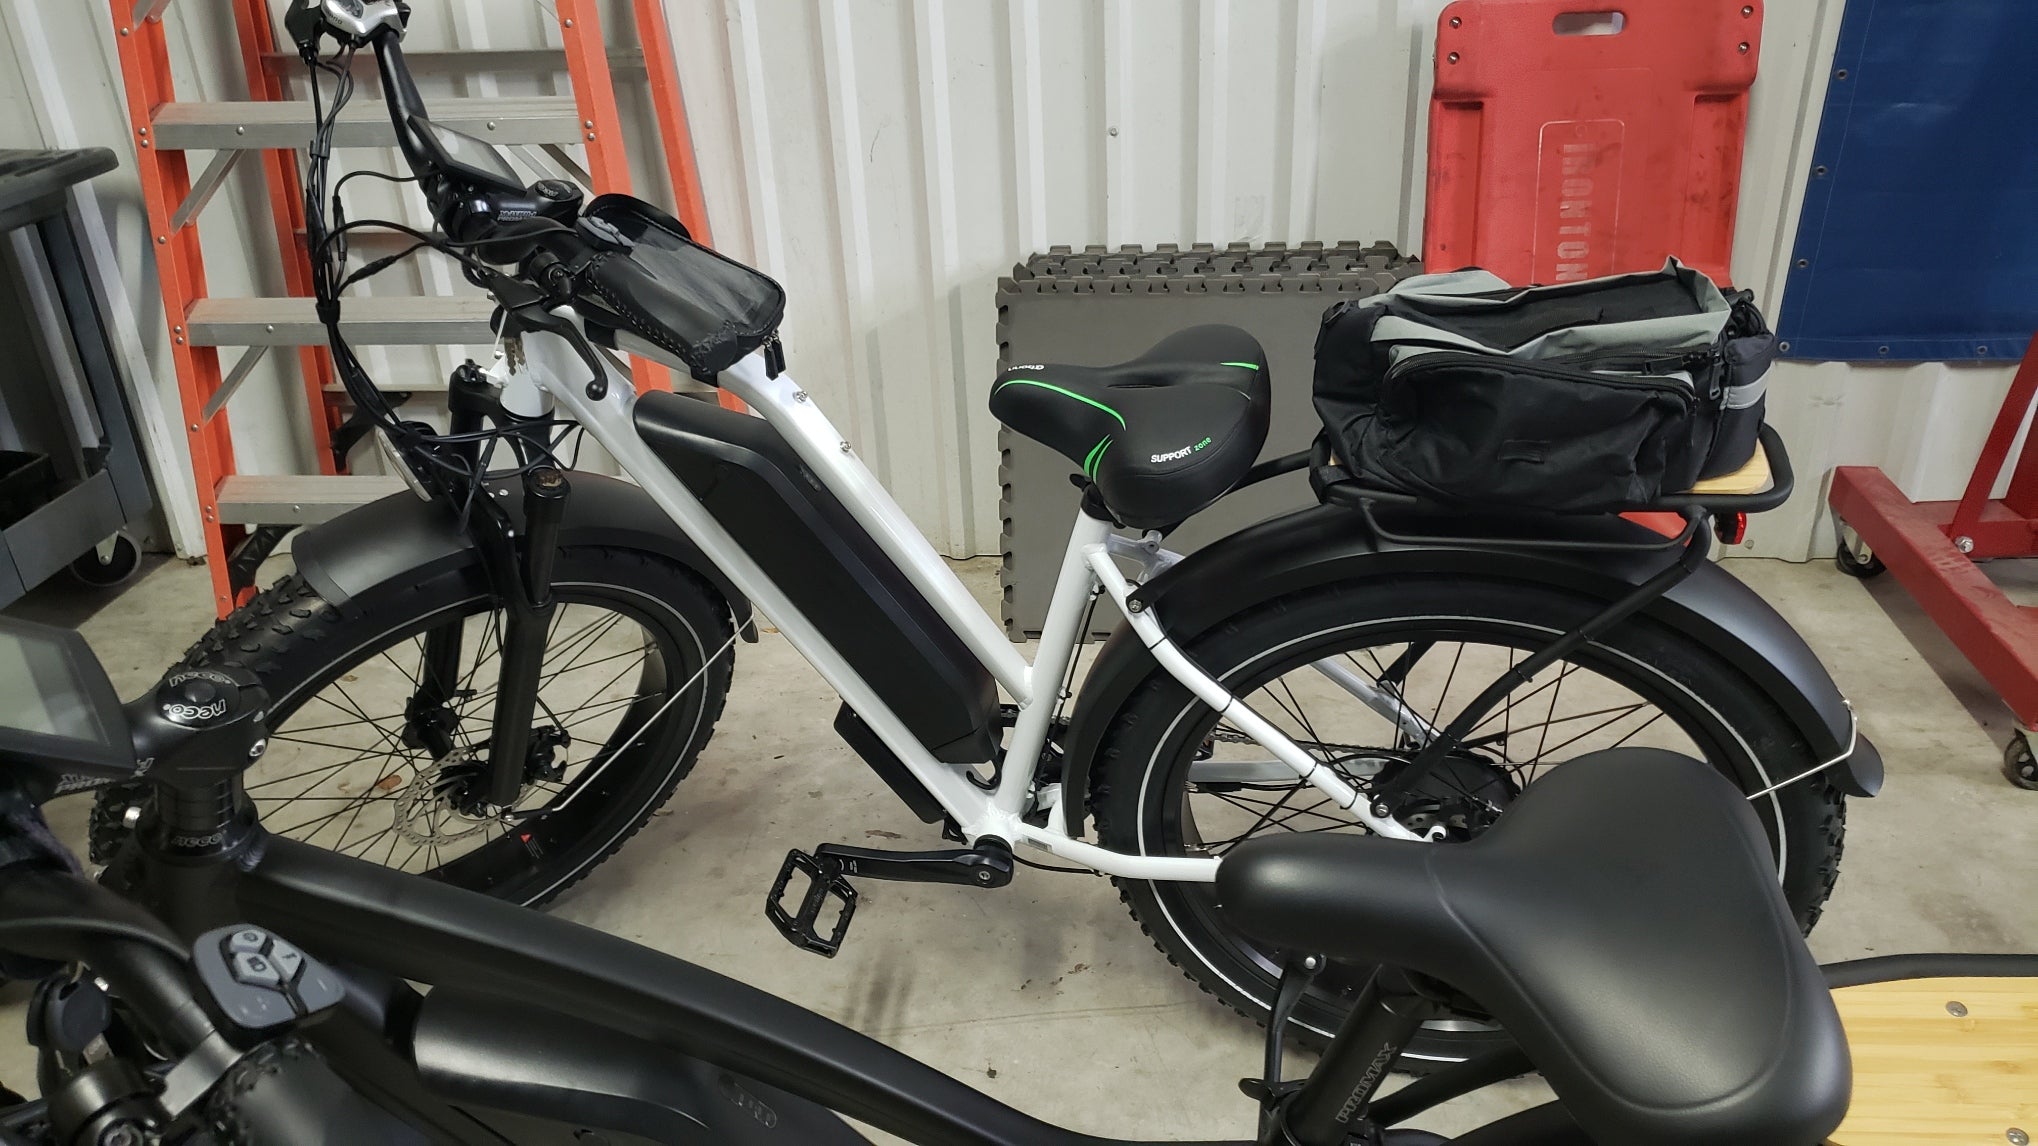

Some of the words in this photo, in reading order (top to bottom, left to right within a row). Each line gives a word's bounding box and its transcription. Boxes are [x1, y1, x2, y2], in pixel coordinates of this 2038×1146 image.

[1555, 143, 1594, 281] IRONTON
[1150, 445, 1191, 463] SUPPORT
[1193, 437, 1211, 451] zone
[1335, 1042, 1397, 1123] PROMAX
